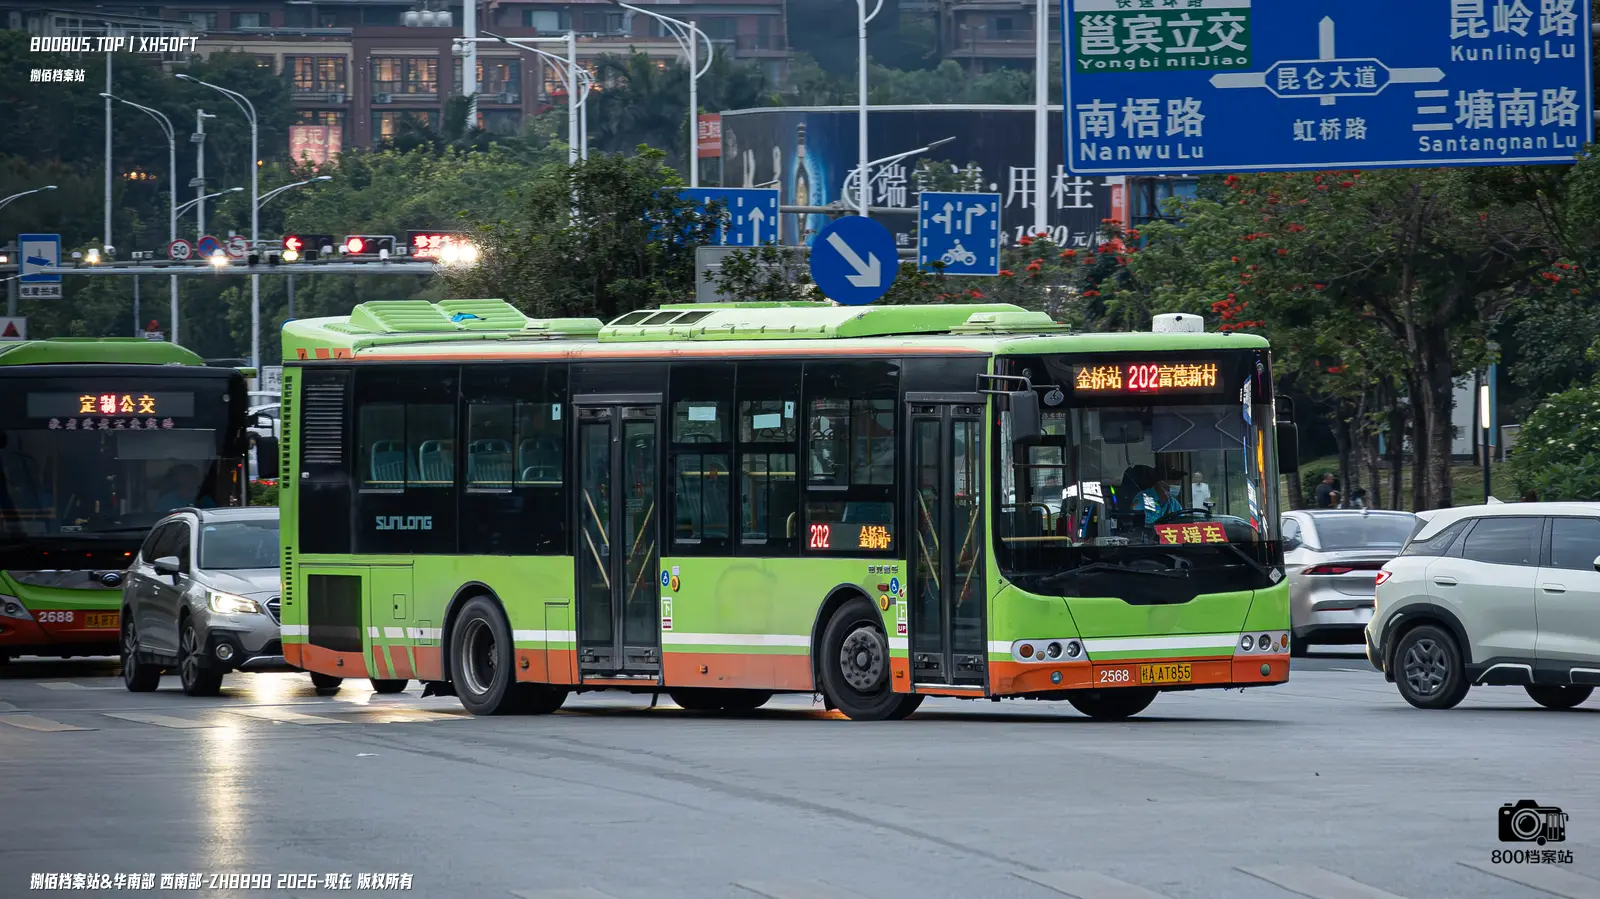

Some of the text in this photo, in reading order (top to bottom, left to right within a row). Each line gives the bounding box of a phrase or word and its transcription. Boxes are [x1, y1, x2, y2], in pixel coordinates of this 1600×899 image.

[1449, 0, 1578, 40] 昆岭路
[1079, 11, 1247, 55] 邕宾立交
[1277, 65, 1378, 91] 昆仑大道
[1076, 97, 1206, 140] 南梧路
[1412, 86, 1580, 131] 三塘南路
[1292, 117, 1368, 142] 虹桥路
[1552, 132, 1577, 149] Lu
[1080, 142, 1204, 161] Nanwu Lu
[173, 245, 187, 256] 50
[1076, 363, 1218, 389] 金桥站 202 富德新村
[79, 394, 156, 413] 定制公交
[376, 516, 432, 530] SUNLONG
[810, 524, 830, 548] 202
[1160, 525, 1224, 544] 支援车
[39, 611, 73, 623] 2688
[1100, 669, 1129, 683] 2568
